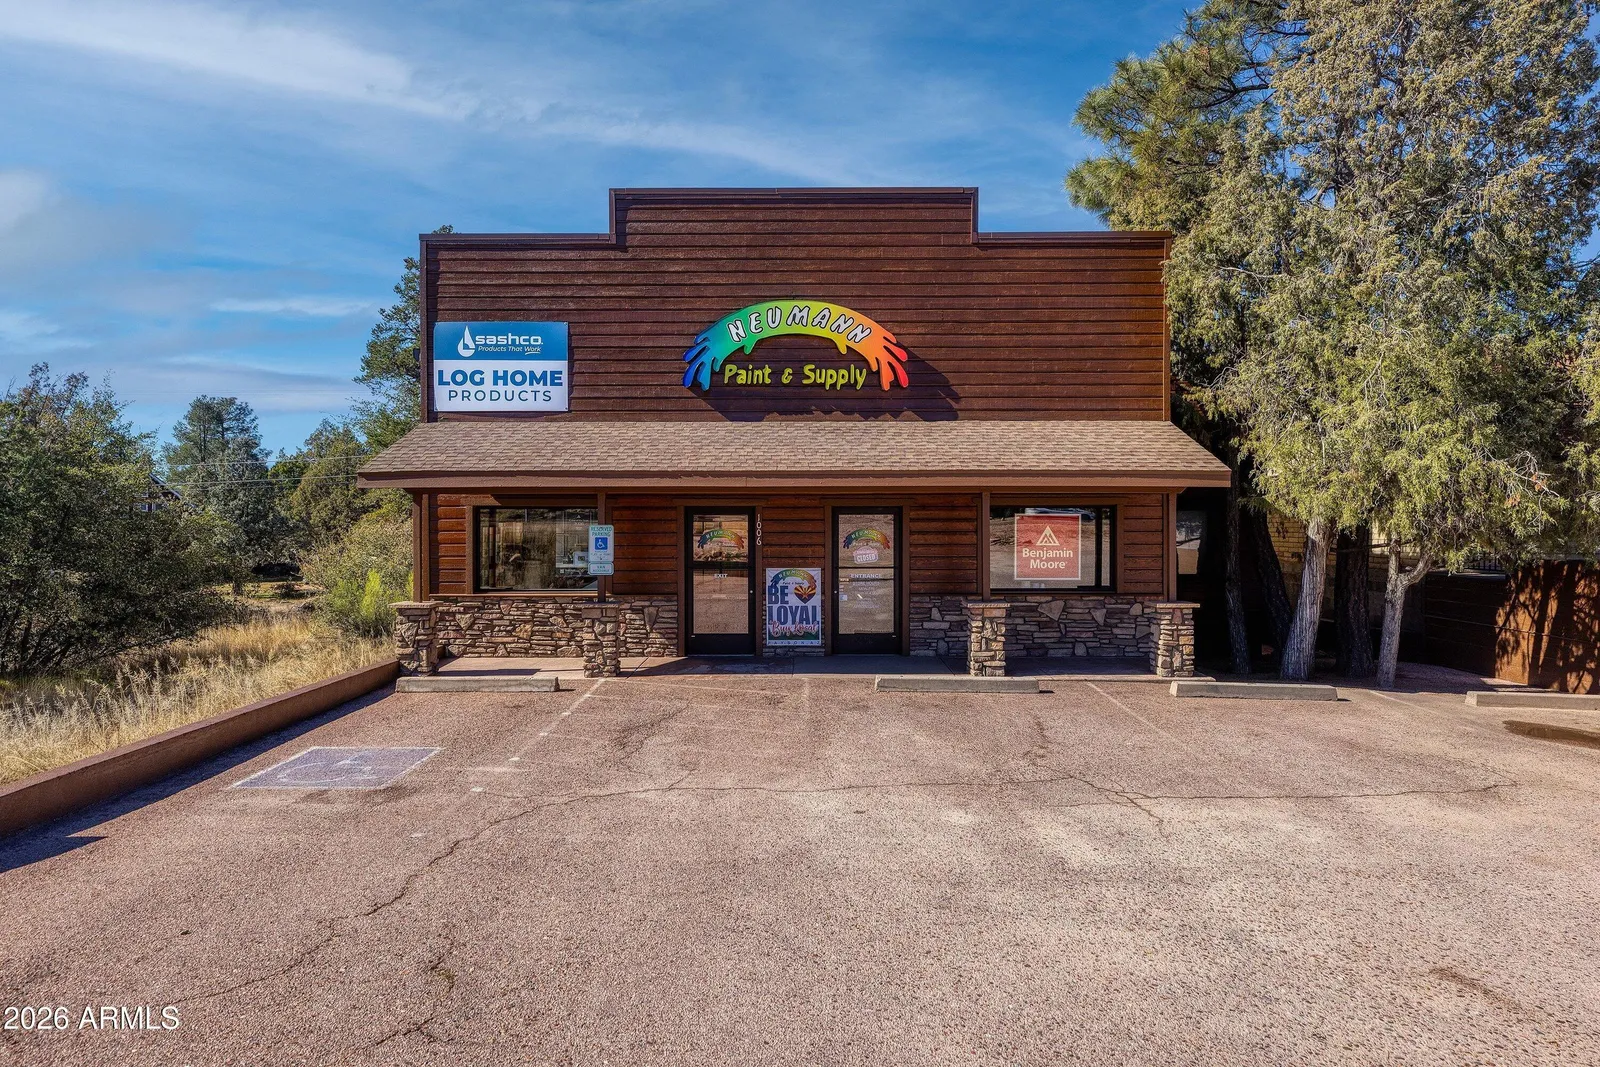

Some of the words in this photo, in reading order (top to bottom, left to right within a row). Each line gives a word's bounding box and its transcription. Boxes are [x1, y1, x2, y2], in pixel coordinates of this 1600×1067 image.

[727, 305, 872, 344] NEUMANN
[524, 345, 542, 353] Work
[437, 369, 486, 386] LOG
[492, 369, 563, 387] HOME
[724, 363, 772, 384] Paint
[781, 367, 793, 383] &
[802, 364, 867, 391] Supply
[448, 390, 552, 402] PRODUCTS
[857, 554, 876, 562] CLOSED
[1022, 547, 1074, 560] Benjamin
[1029, 559, 1066, 569] Moore
[768, 585, 789, 605] BE
[768, 605, 820, 626] LOYAL
[771, 620, 793, 638] Buy
[793, 620, 818, 637] Local
